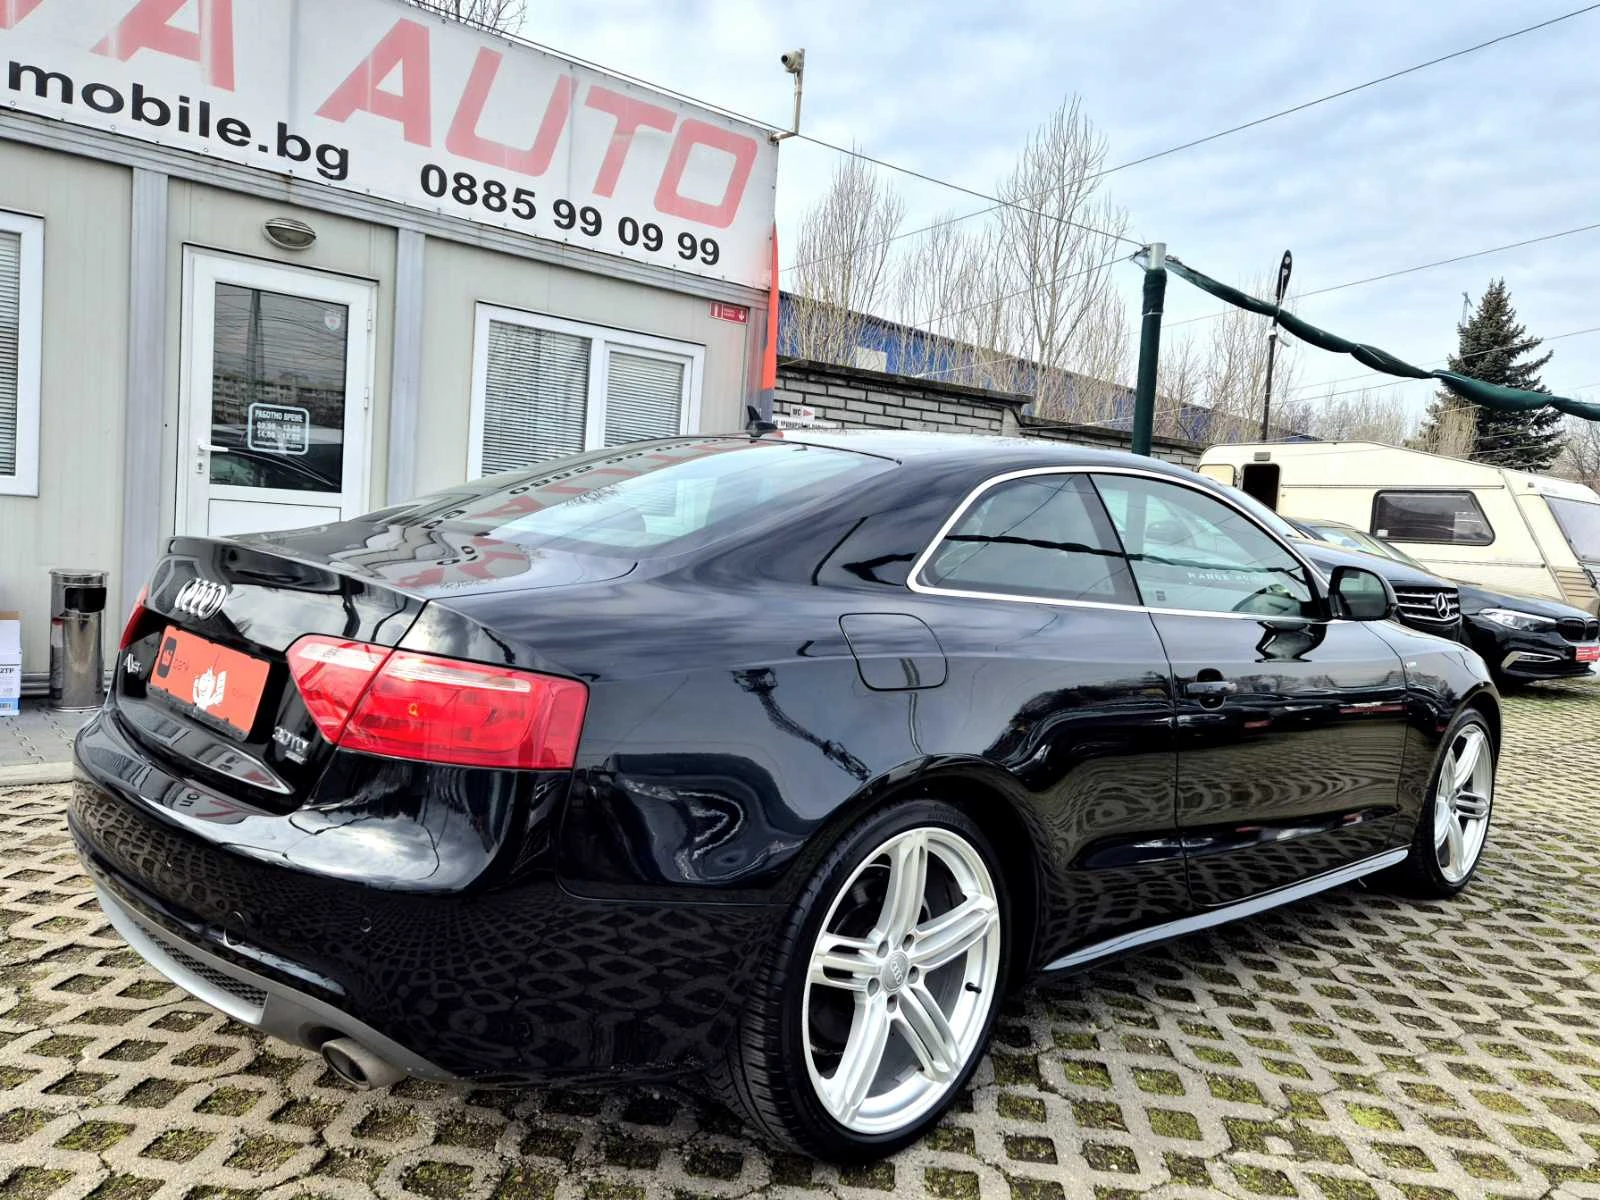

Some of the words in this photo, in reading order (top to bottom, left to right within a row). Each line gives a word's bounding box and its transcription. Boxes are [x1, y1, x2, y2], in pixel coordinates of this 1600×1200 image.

[8, 60, 350, 181] mobile.bg
[314, 17, 759, 230] AUTO
[420, 163, 537, 220] 0885
[552, 199, 603, 237] 99
[617, 216, 664, 252] 09
[677, 232, 720, 266] 99
